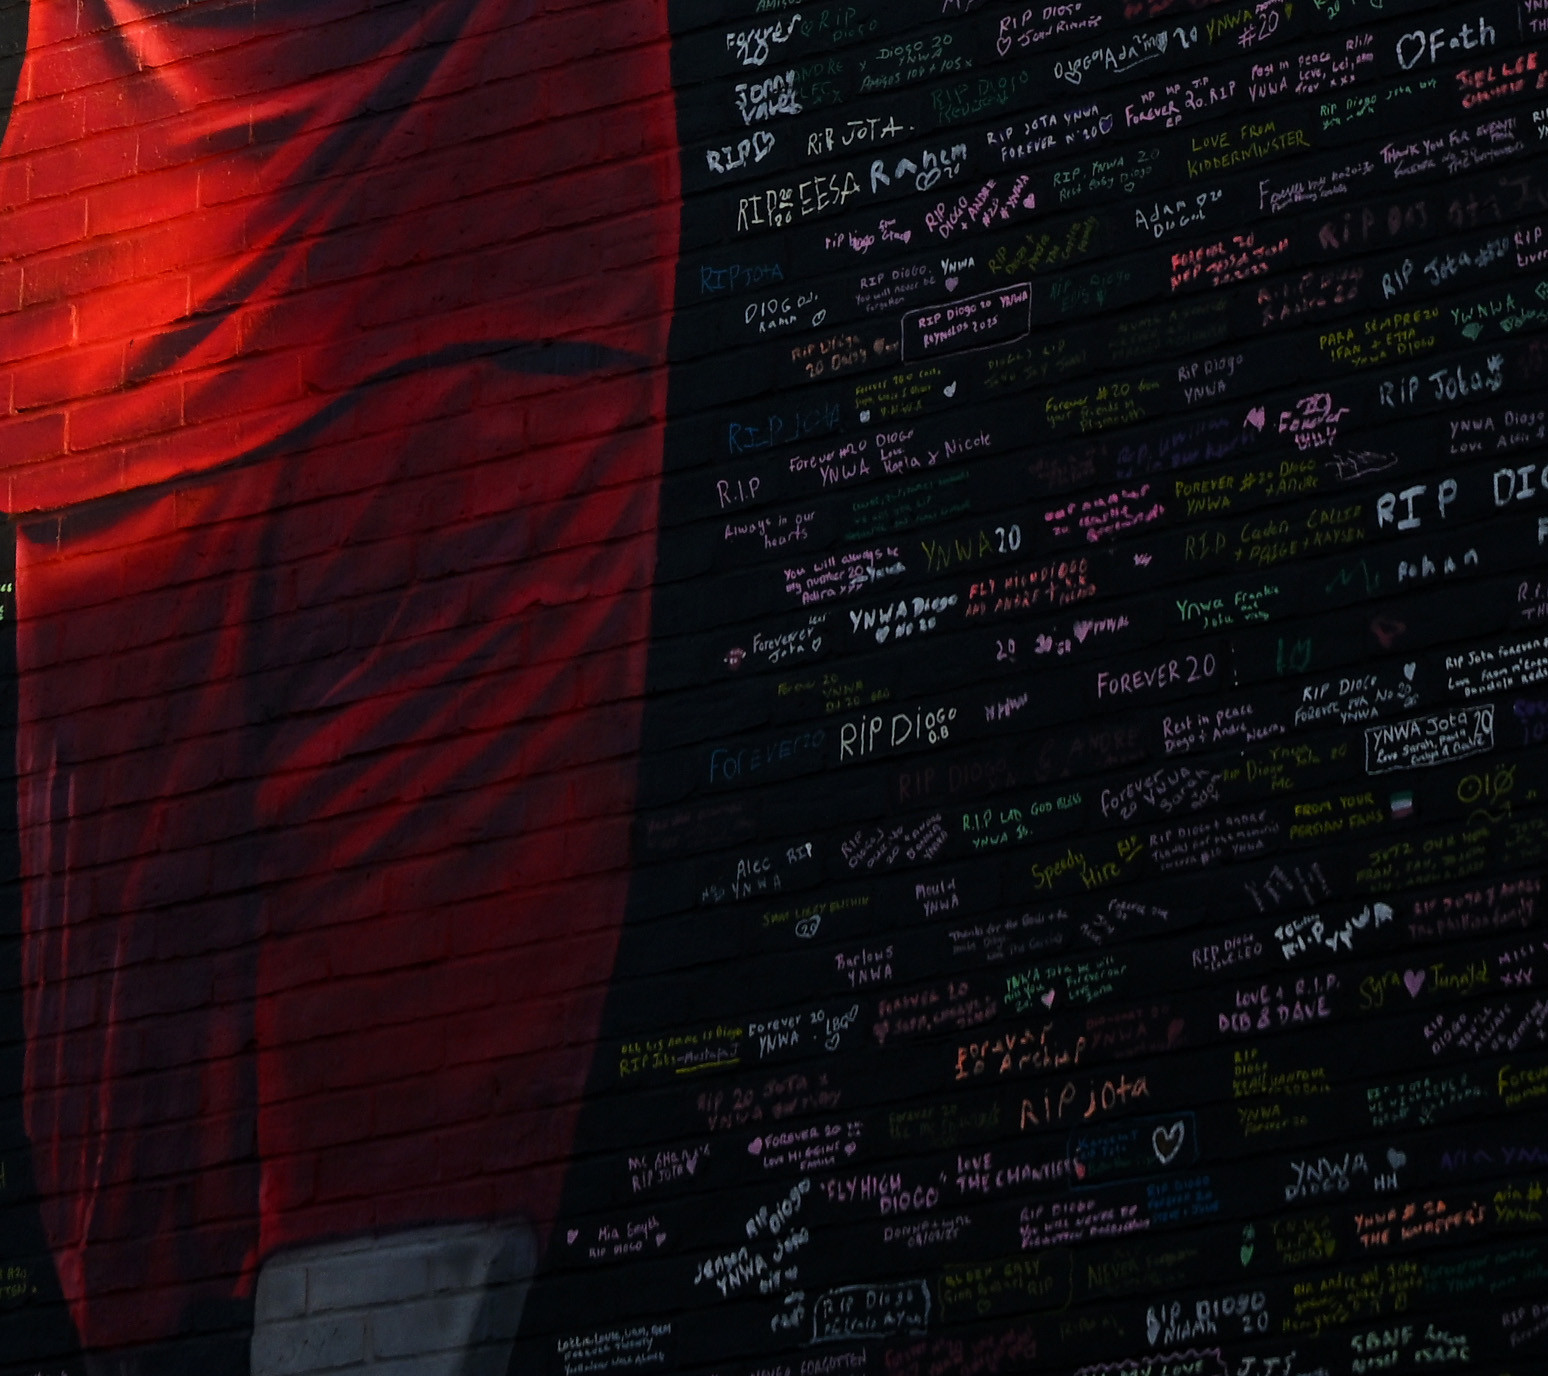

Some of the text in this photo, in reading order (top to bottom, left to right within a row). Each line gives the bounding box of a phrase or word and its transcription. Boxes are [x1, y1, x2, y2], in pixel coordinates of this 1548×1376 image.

[1192, 132, 1230, 152] LOVE
[1377, 480, 1457, 530] RIP
[1186, 654, 1215, 682] 20
